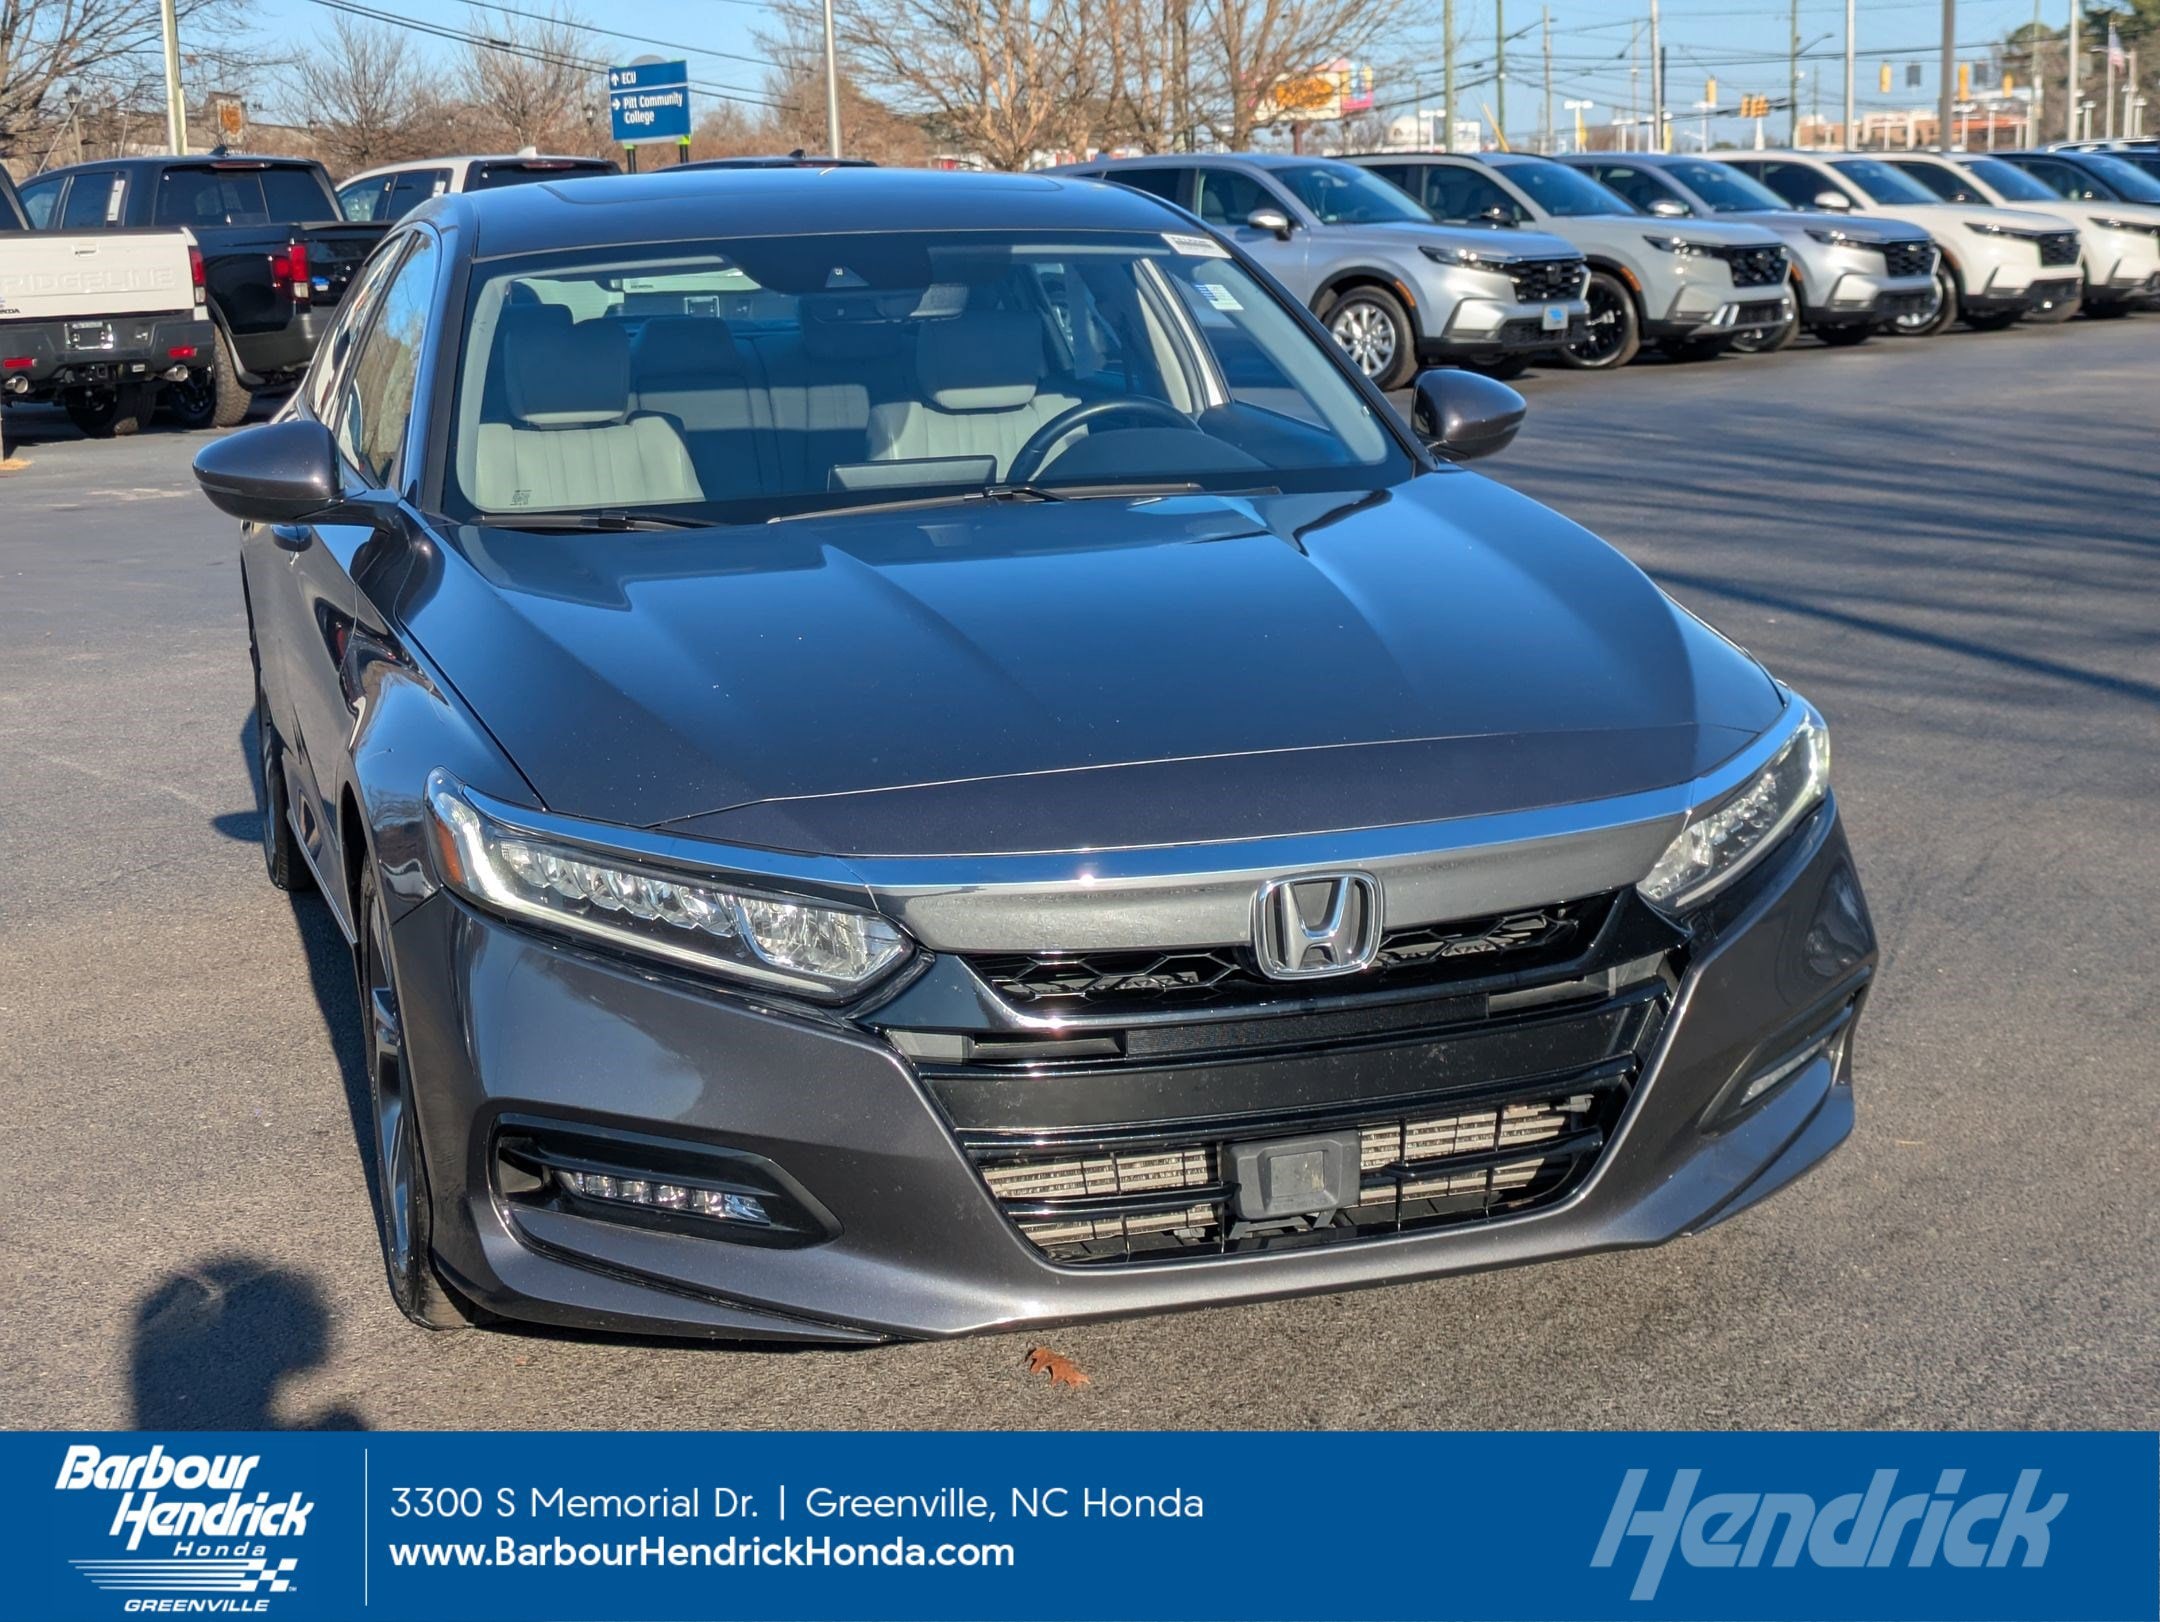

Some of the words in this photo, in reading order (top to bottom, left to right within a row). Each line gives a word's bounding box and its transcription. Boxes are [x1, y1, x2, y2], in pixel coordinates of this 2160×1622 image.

[621, 71, 637, 85] ECU
[623, 96, 638, 109] Pitt
[639, 91, 683, 107] Community
[624, 110, 655, 125] College
[0, 265, 175, 292] RIDGELINE
